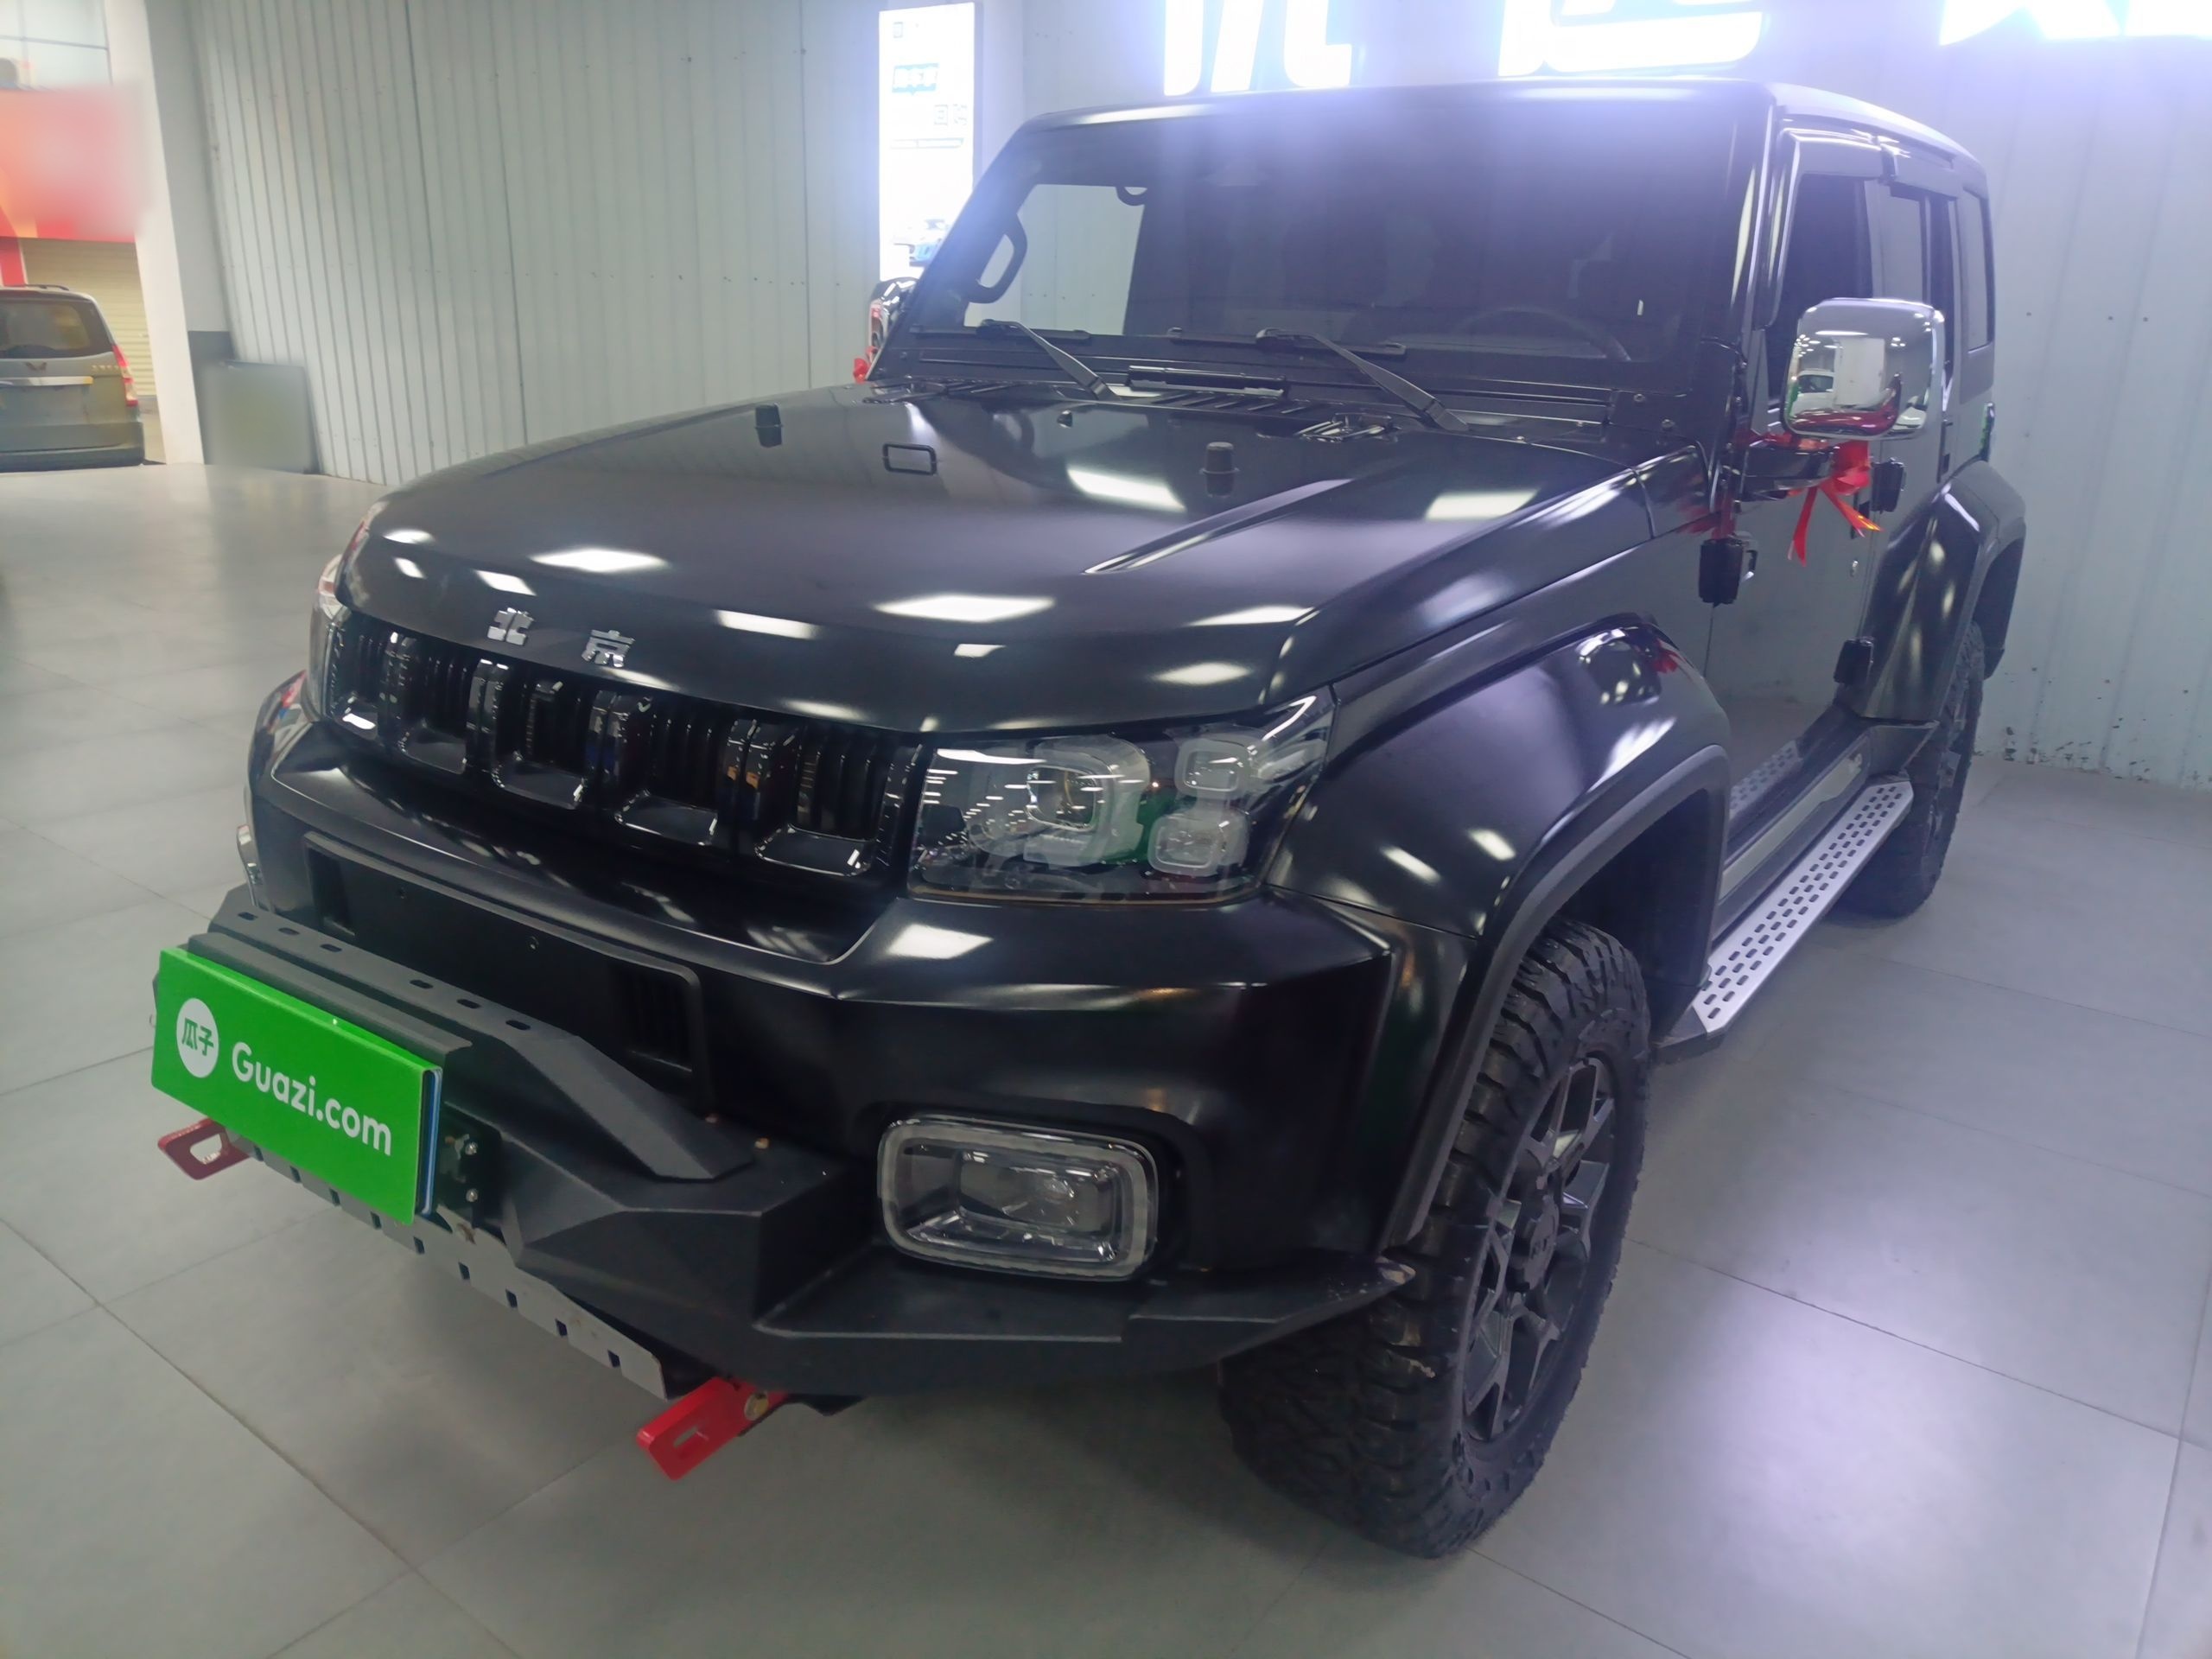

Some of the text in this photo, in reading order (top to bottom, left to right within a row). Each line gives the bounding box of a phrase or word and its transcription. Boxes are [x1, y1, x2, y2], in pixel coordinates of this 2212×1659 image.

[487, 607, 636, 668] 北京
[181, 1017, 214, 1057] 瓜子
[232, 1041, 392, 1156] Guazi.com
